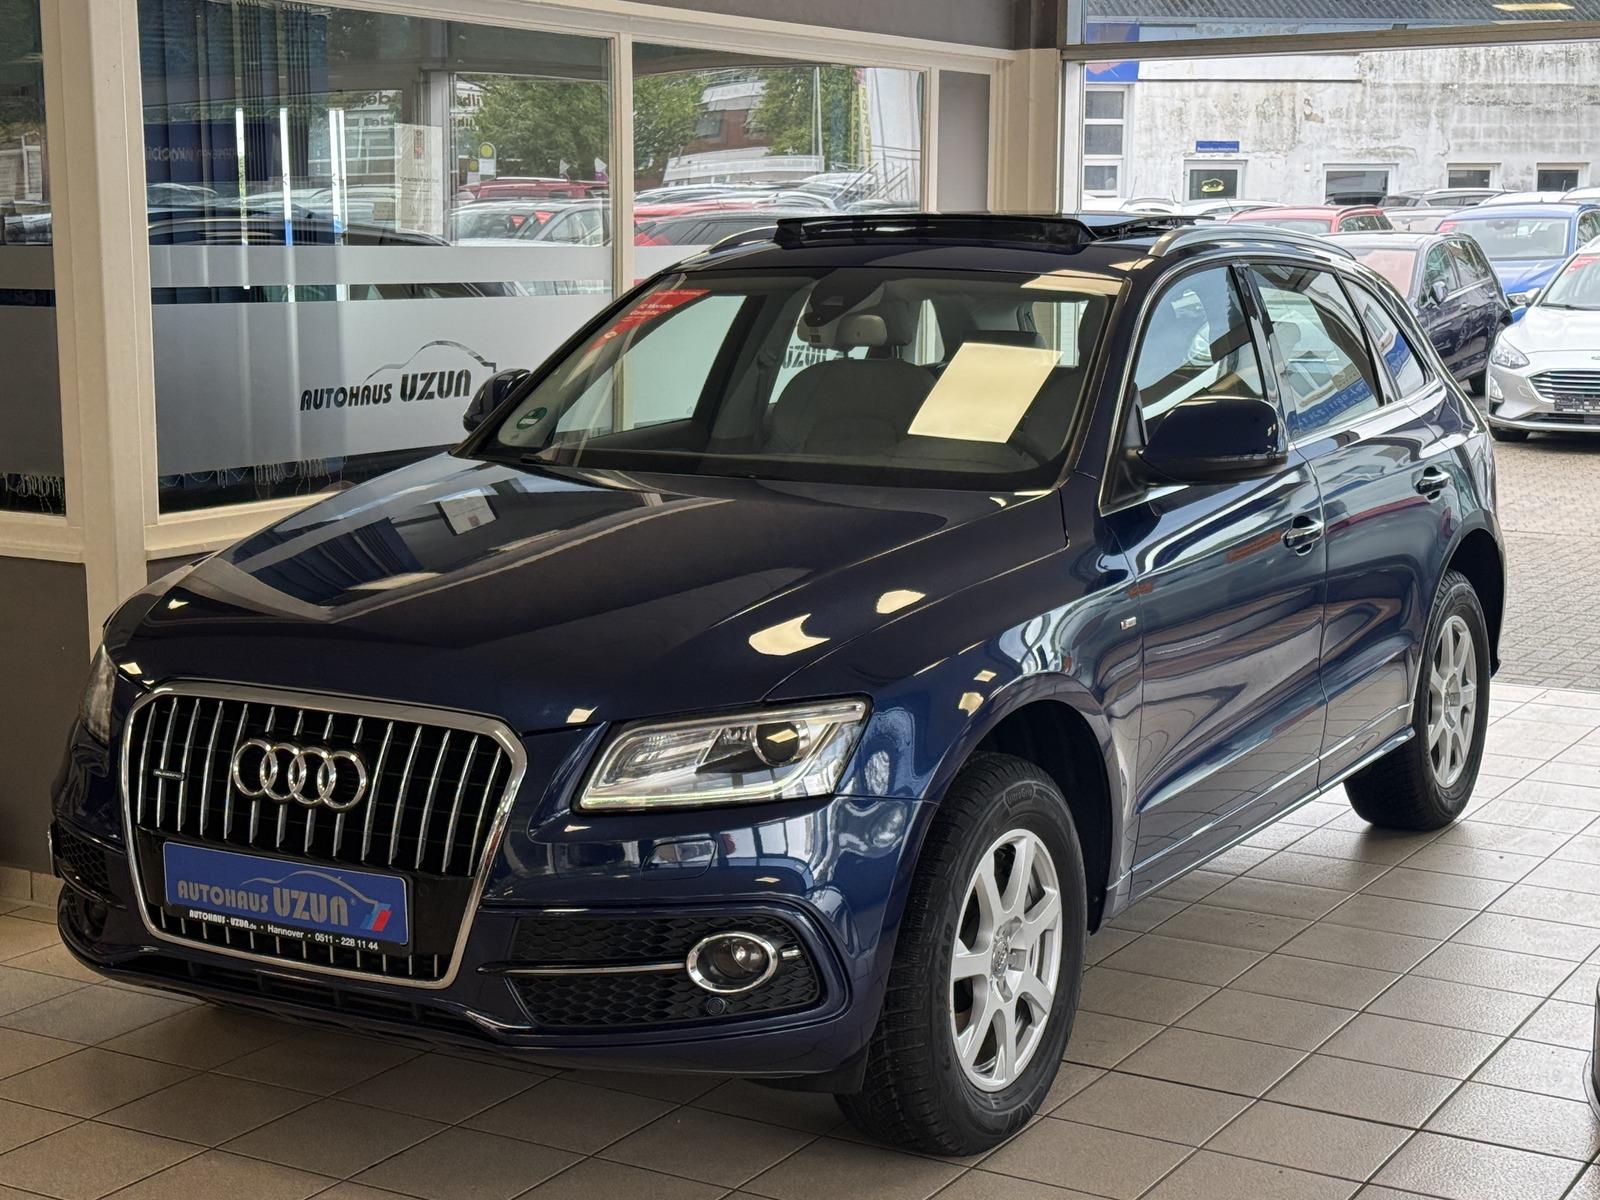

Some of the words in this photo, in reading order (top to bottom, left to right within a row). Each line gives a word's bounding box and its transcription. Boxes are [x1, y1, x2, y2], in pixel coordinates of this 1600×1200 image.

[300, 383, 393, 411] AUTOHAUS
[400, 369, 472, 402] UZUN
[177, 880, 269, 914] AUTOHAUS
[273, 887, 349, 927] UZUN
[267, 924, 304, 939] Hannover
[315, 934, 333, 944] 0511
[340, 936, 355, 946] 228
[357, 938, 366, 948] 11
[367, 940, 379, 950] 44
